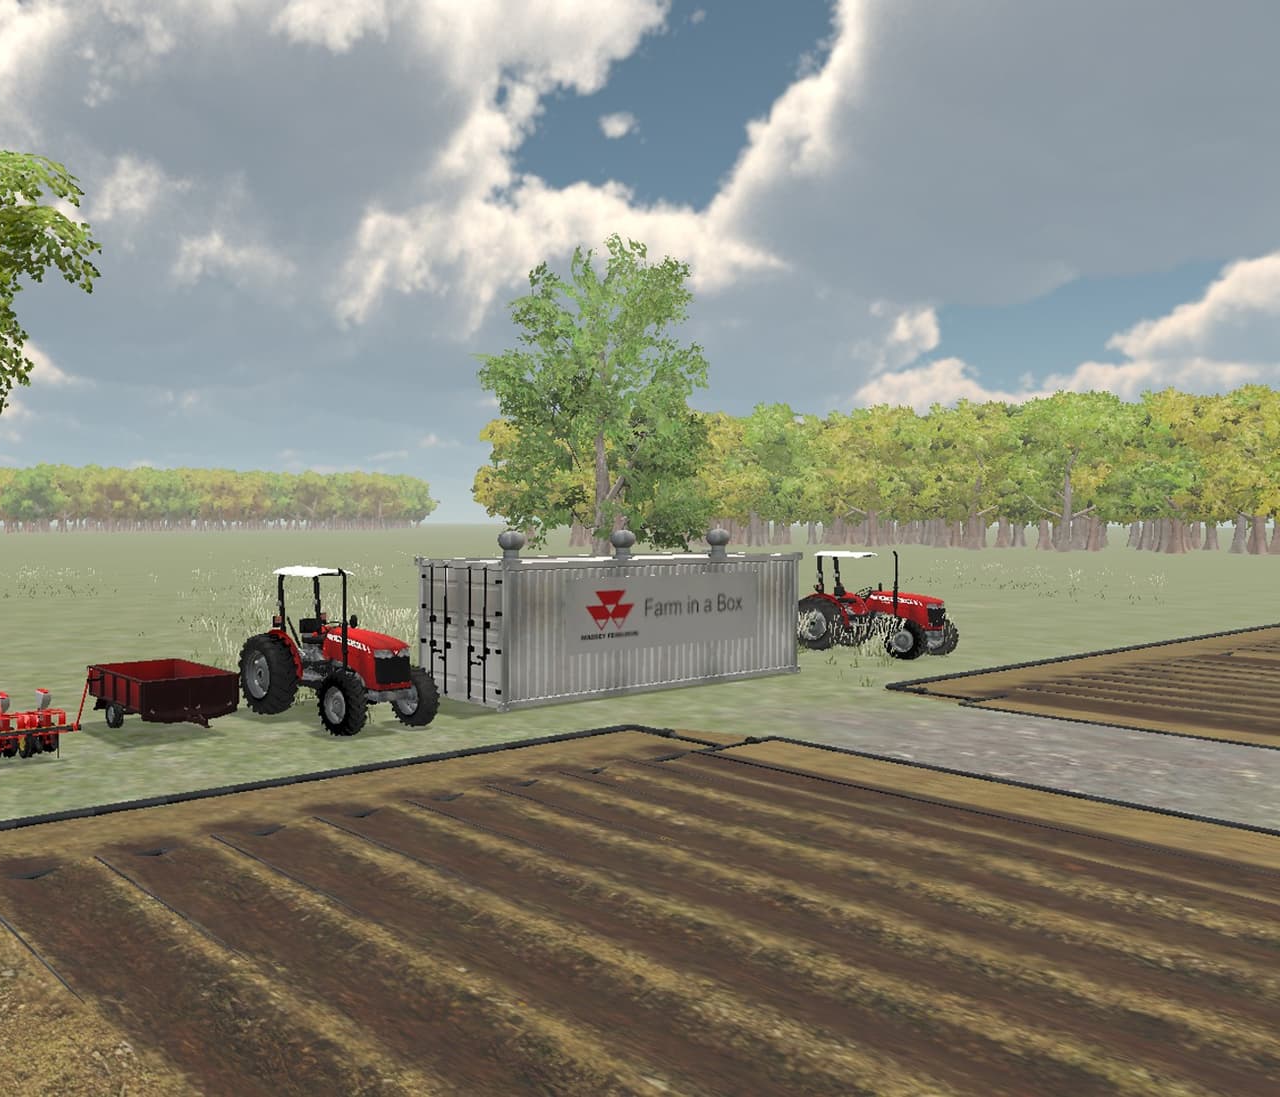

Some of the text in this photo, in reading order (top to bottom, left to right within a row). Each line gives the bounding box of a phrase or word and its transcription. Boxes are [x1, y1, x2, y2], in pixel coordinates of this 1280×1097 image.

[644, 593, 743, 617] Farm in a Box
